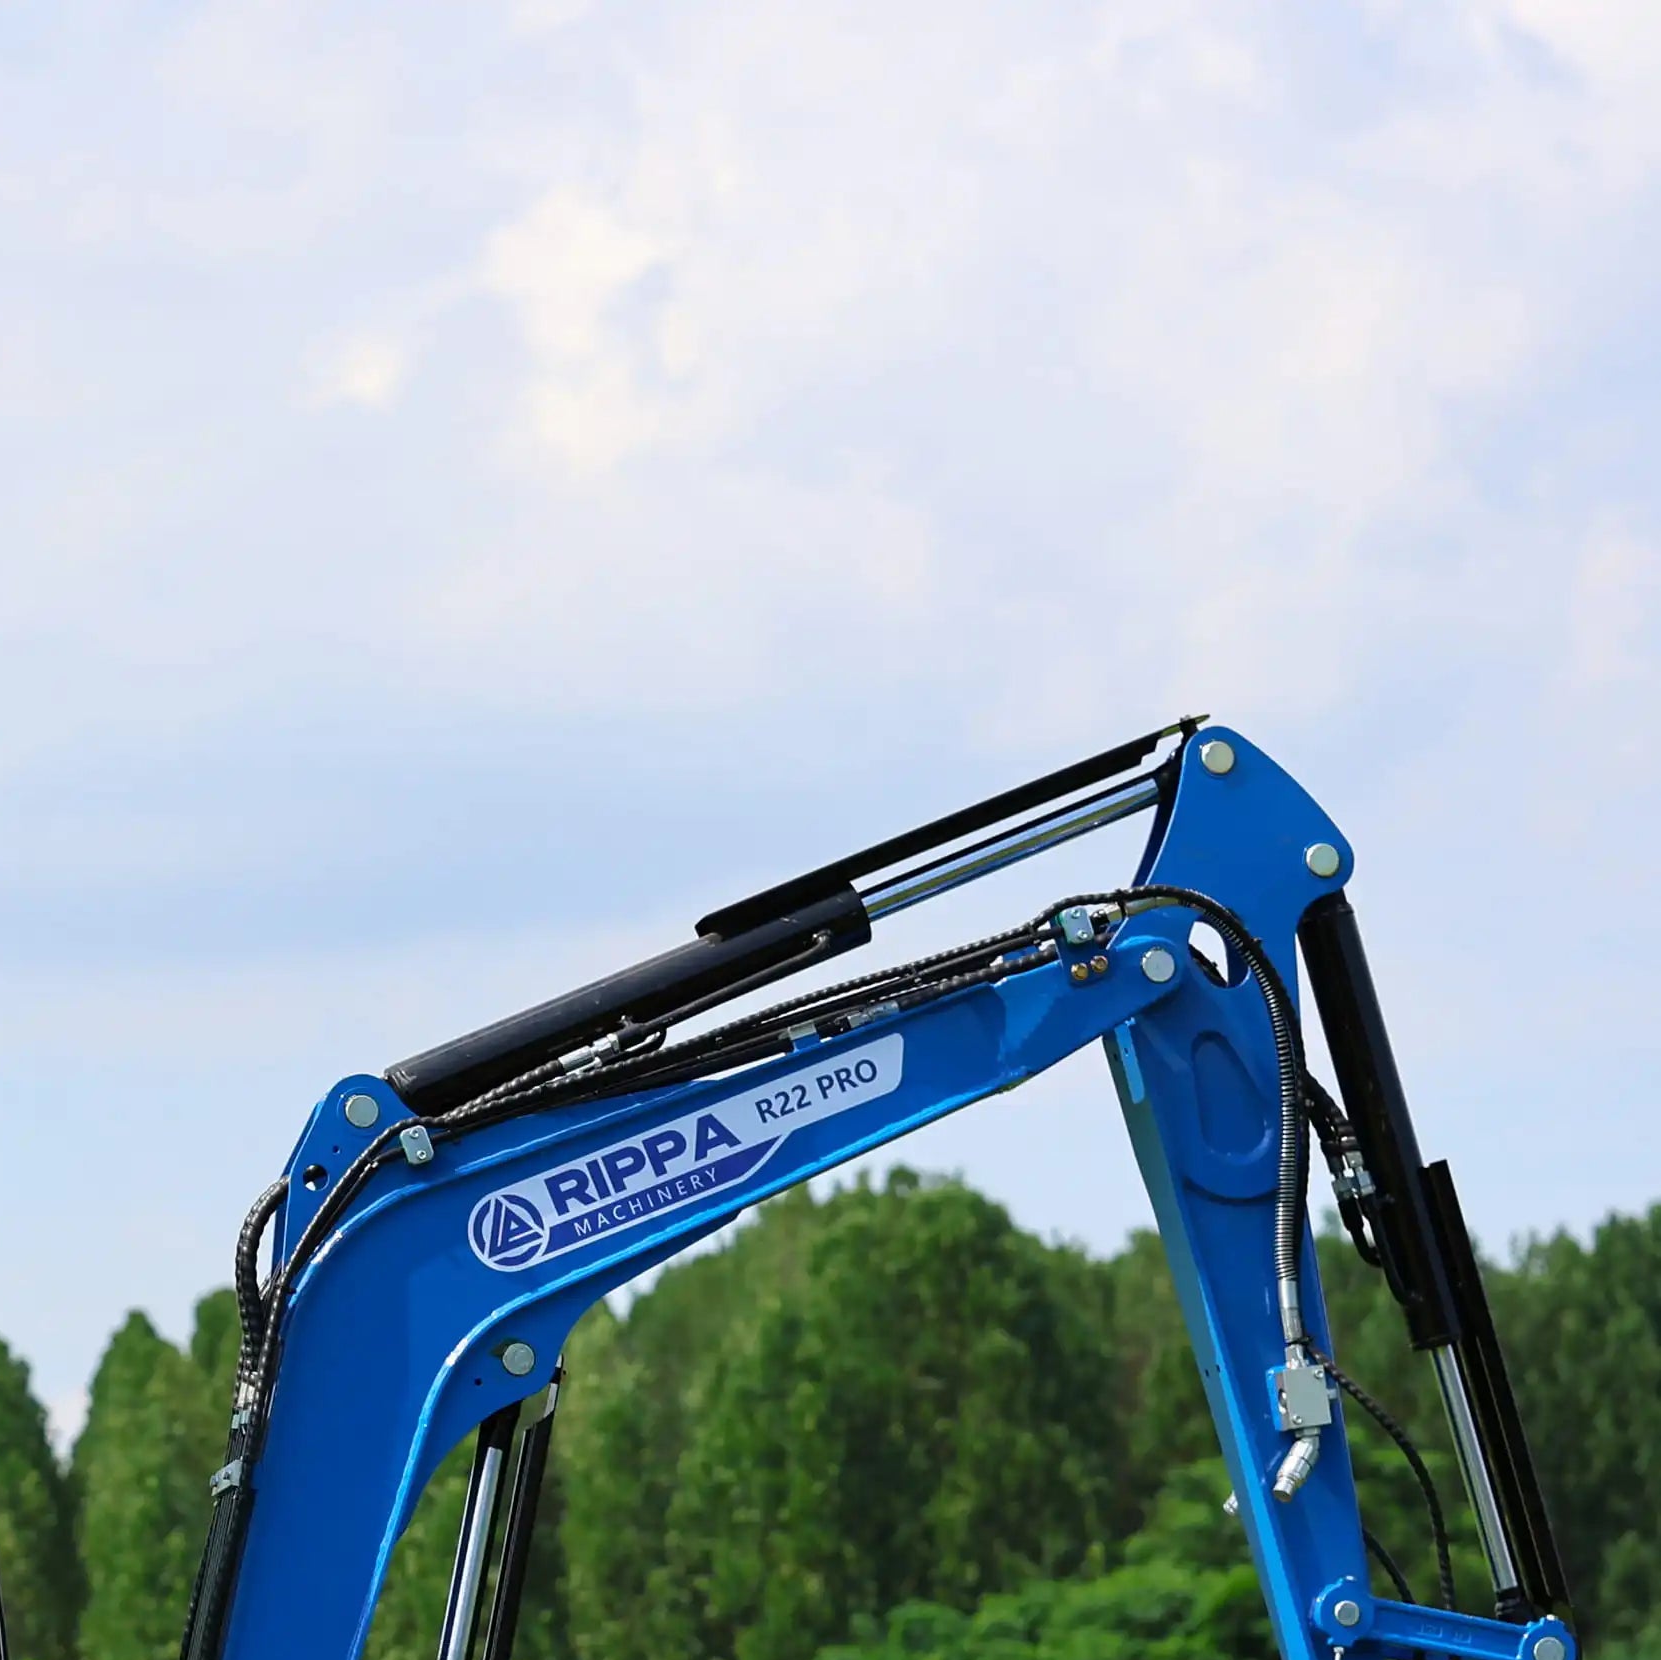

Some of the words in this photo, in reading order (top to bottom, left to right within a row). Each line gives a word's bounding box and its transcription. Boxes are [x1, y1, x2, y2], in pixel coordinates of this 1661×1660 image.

[755, 1084, 812, 1123] R22
[816, 1059, 877, 1099] PRO
[544, 1113, 742, 1216] RIPPA
[574, 1168, 717, 1237] MACHINERY
